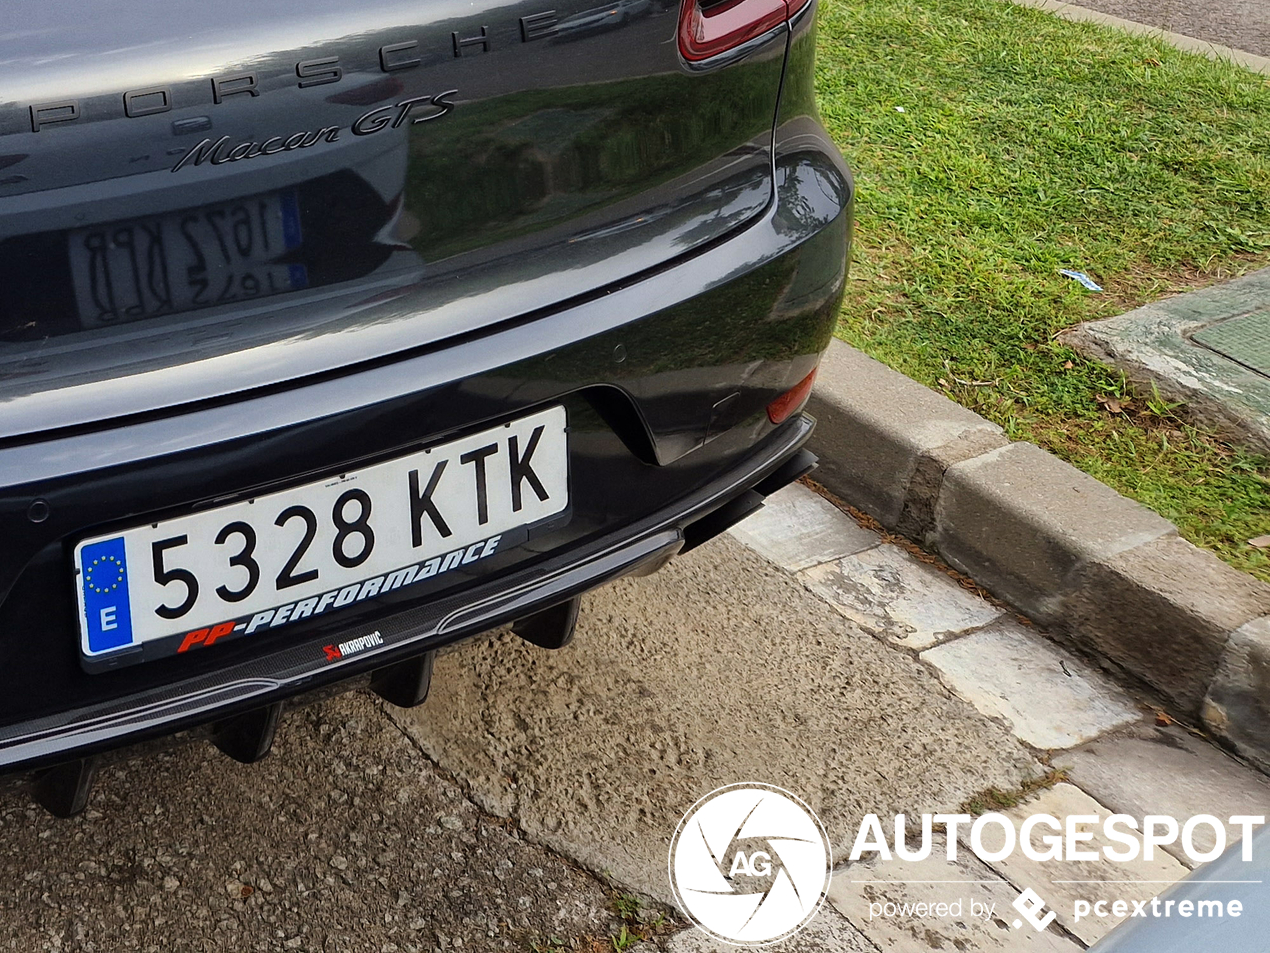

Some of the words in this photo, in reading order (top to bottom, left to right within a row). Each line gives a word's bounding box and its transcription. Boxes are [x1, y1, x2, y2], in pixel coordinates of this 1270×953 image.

[30, 9, 559, 133] PORSCHE
[170, 122, 341, 174] Macan
[351, 89, 459, 137] GTS
[151, 486, 376, 621] 5328
[408, 424, 551, 549] KTK
[100, 605, 118, 632] E
